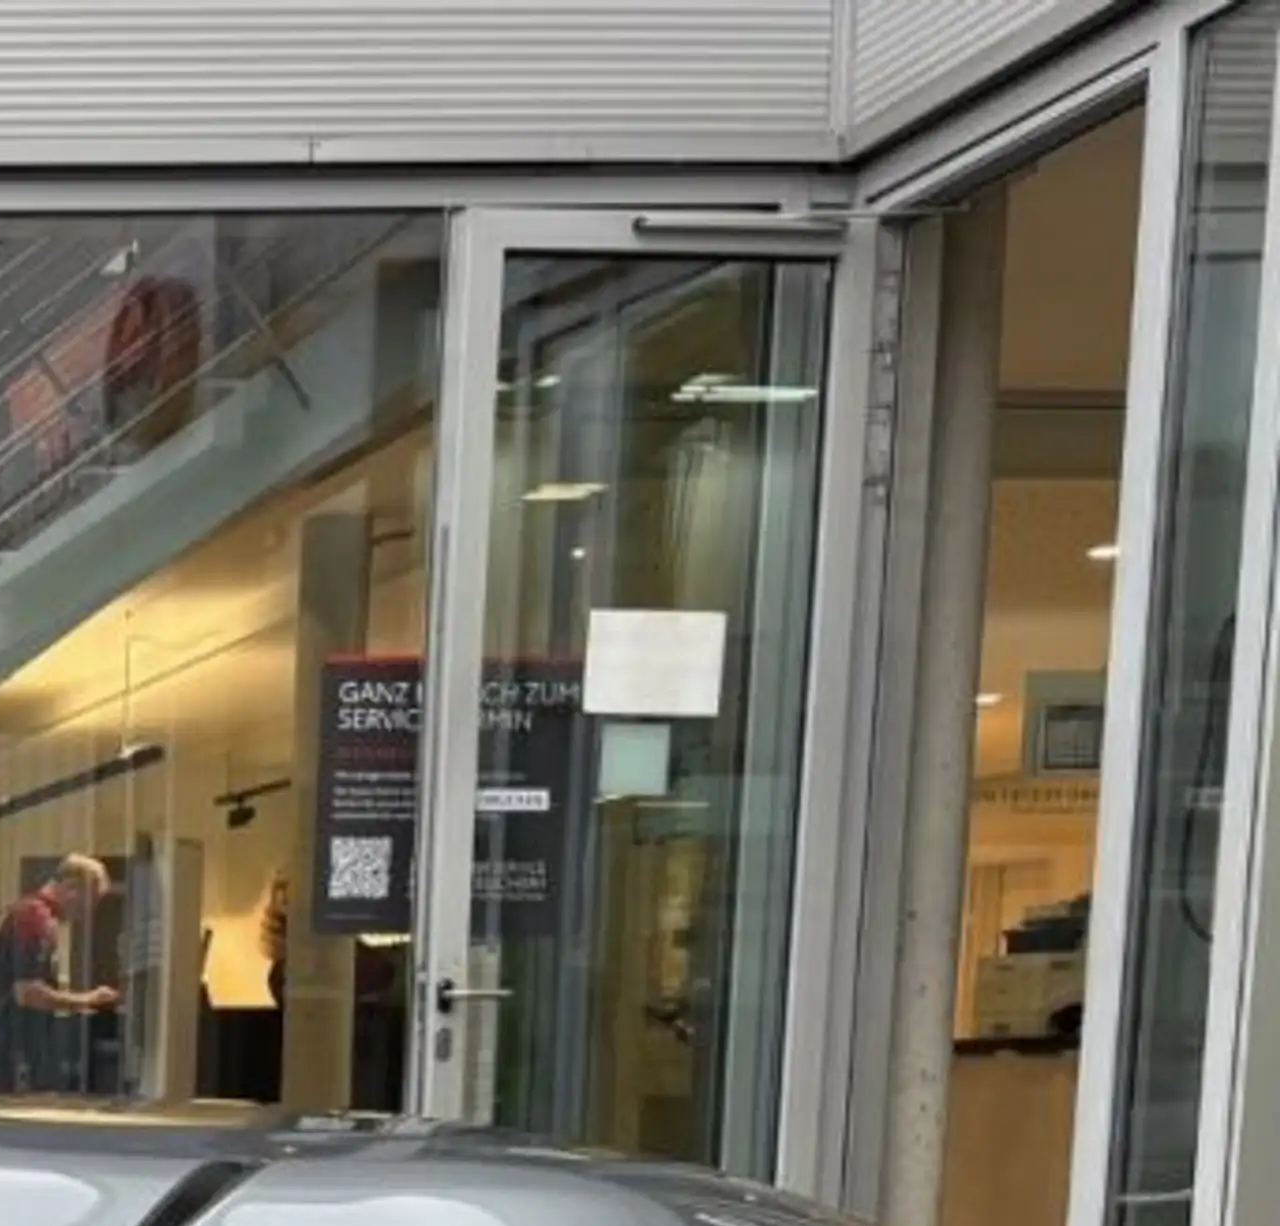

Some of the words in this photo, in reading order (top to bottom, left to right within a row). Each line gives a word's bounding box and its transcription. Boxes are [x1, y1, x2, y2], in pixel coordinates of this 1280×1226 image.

[338, 681, 410, 704] GANZ
[525, 682, 581, 706] ZUM
[337, 708, 426, 732] SERVIC
